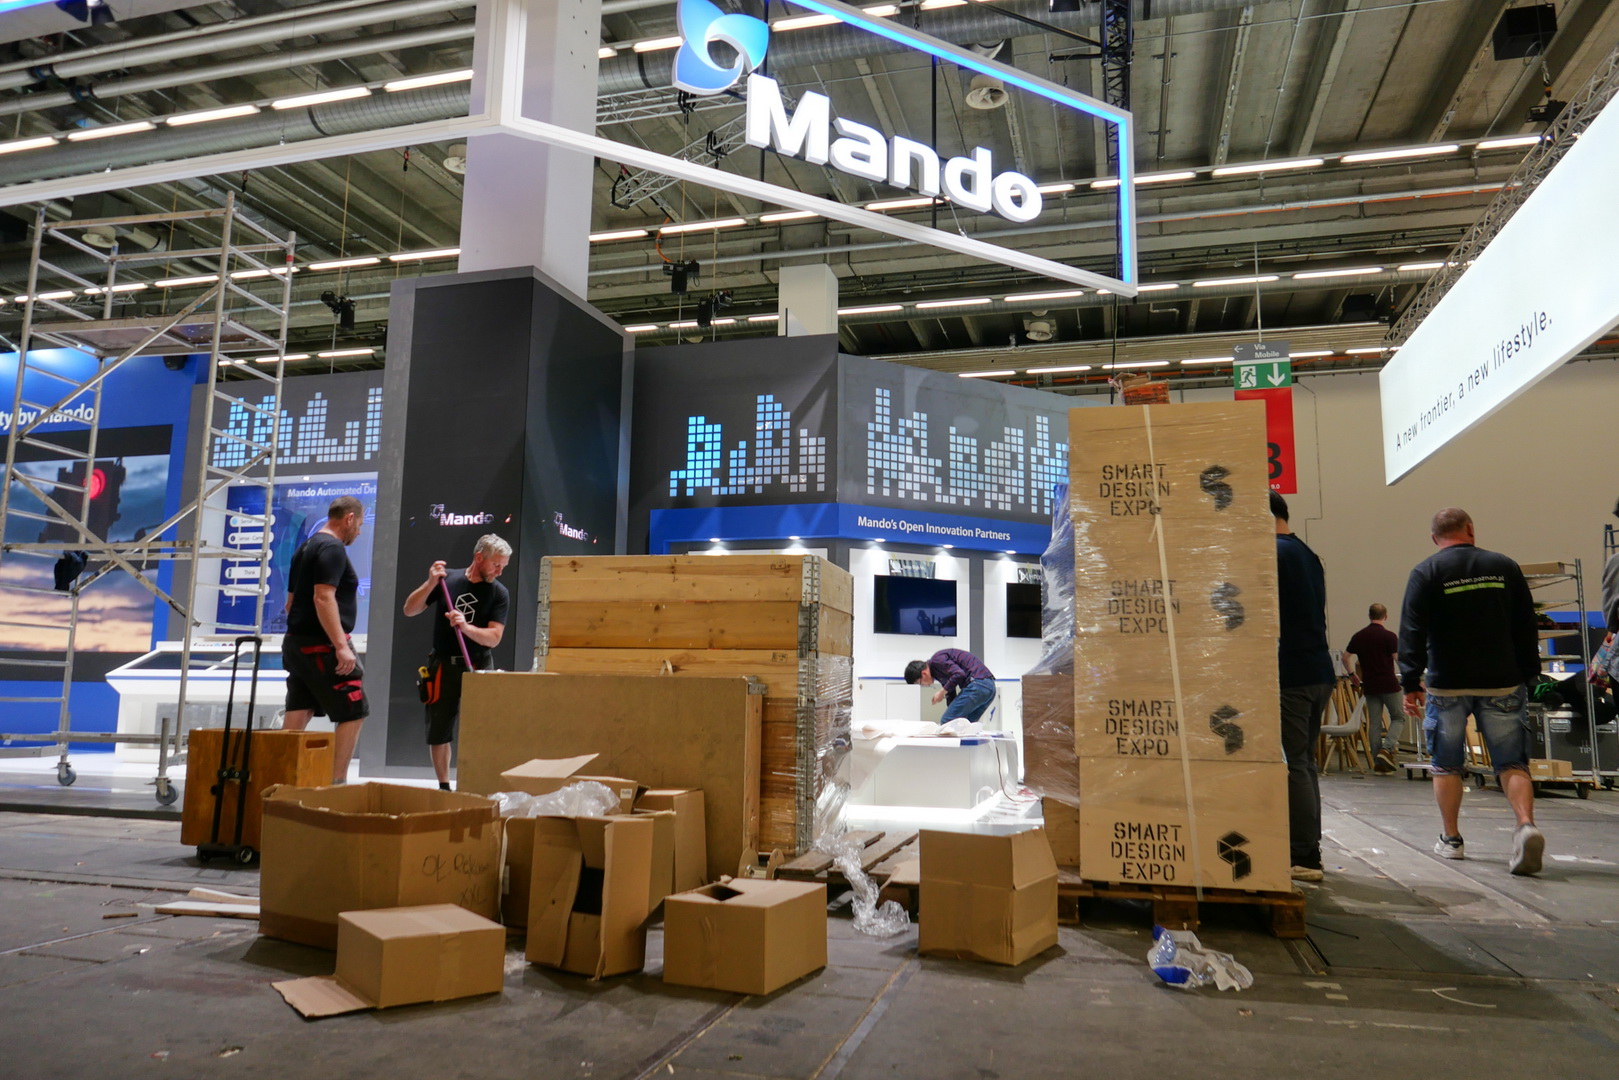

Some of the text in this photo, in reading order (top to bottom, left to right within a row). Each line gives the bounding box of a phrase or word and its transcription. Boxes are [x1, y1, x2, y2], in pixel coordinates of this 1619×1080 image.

[745, 73, 1043, 224] Mando
[1254, 351, 1280, 359] Mobile
[1396, 311, 1552, 451] A new frontier, a new lifestyle.
[41, 403, 95, 424] ando
[1102, 463, 1167, 480] SMART
[288, 487, 316, 498] Mando
[316, 484, 362, 497] Automated
[440, 511, 494, 526] Mando
[559, 522, 589, 542] Mando
[899, 519, 925, 534] Open
[926, 522, 974, 538] Innovation
[975, 527, 1011, 541] Partners
[1111, 579, 1176, 597] SMART
[1108, 598, 1180, 615] DESIGN
[1119, 617, 1169, 634] EXPO
[1108, 699, 1175, 717] SMART
[1105, 718, 1179, 737] DESIGN
[1116, 737, 1169, 756] EXPO
[1113, 822, 1182, 842] SMART
[1111, 841, 1185, 862] DESIGN
[1120, 861, 1176, 882] EXPO
